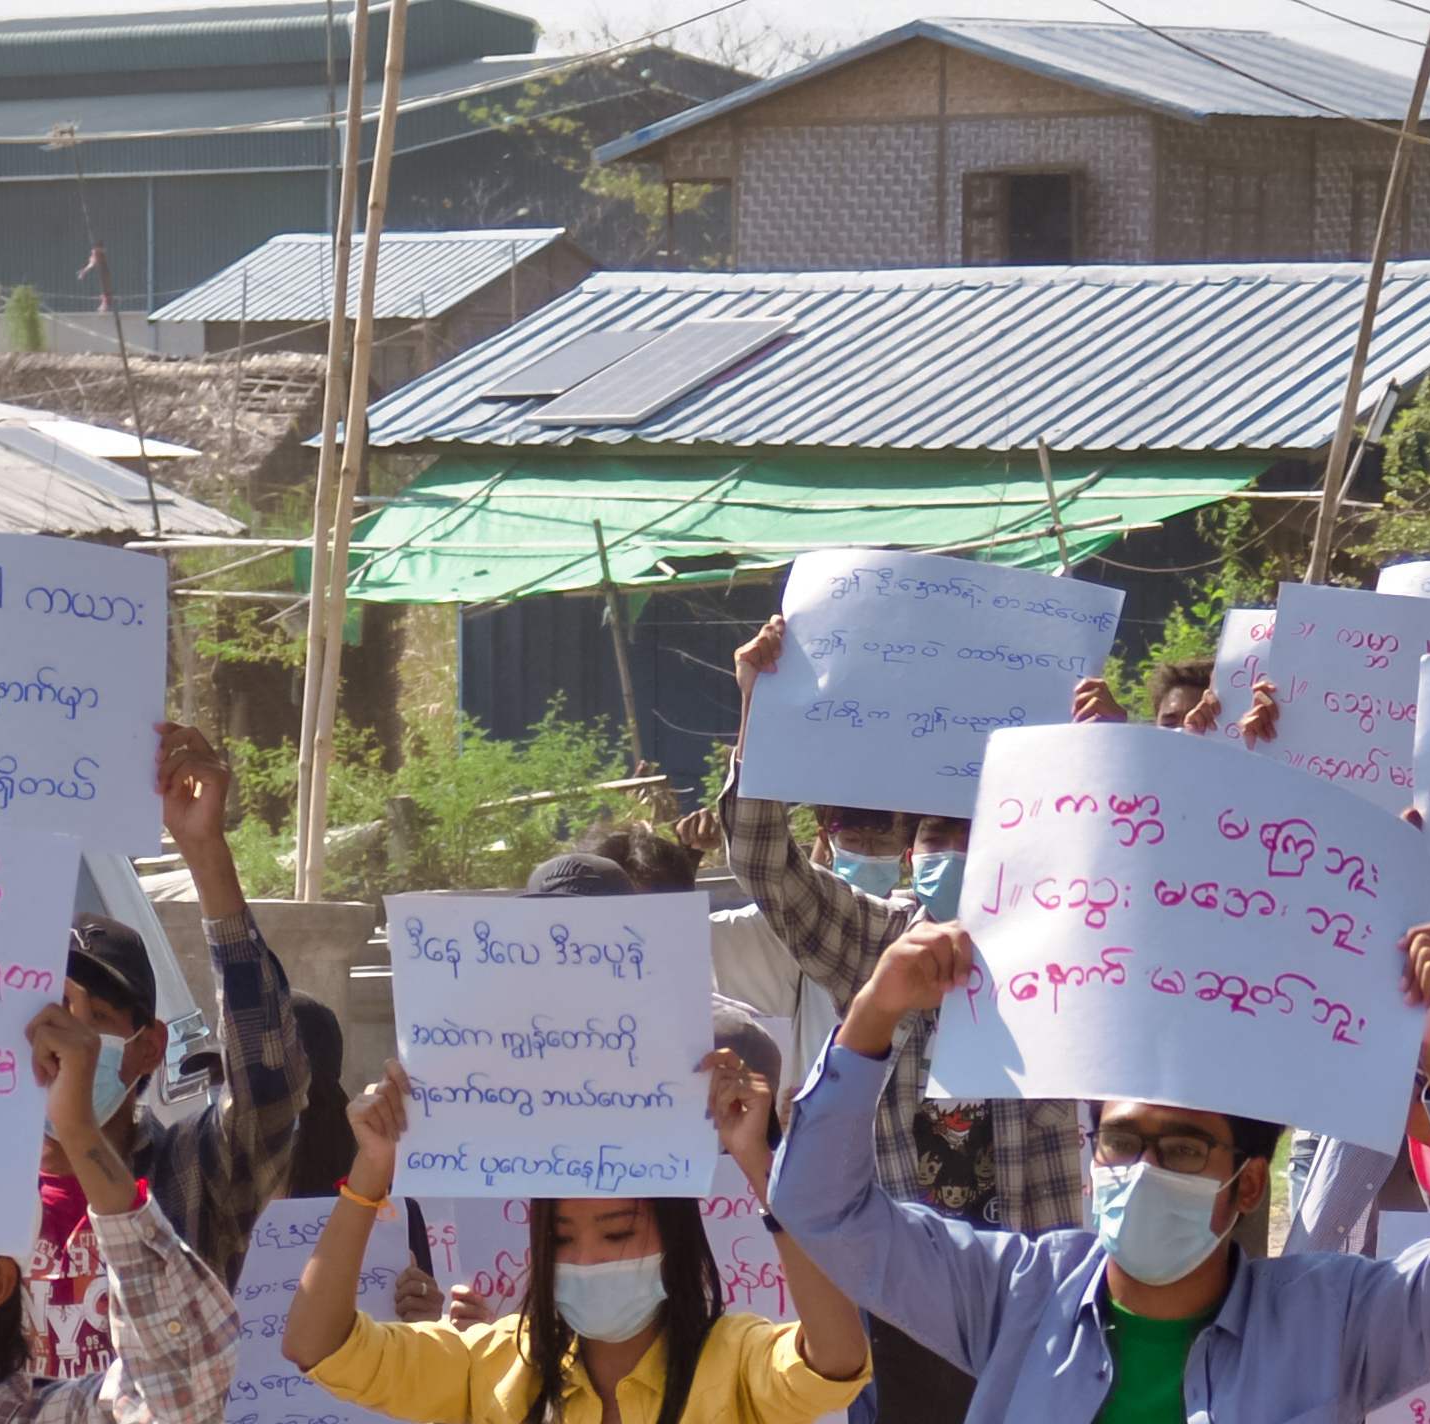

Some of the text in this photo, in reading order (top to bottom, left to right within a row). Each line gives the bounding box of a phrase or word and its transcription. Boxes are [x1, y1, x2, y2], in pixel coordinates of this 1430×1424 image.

[26, 586, 144, 626] ကယား
[1054, 793, 1166, 849] ကမ္ဘာ
[1032, 876, 1133, 930] သွေး
[1009, 946, 1135, 1016] နောက်
[406, 1141, 471, 1172] တောင်
